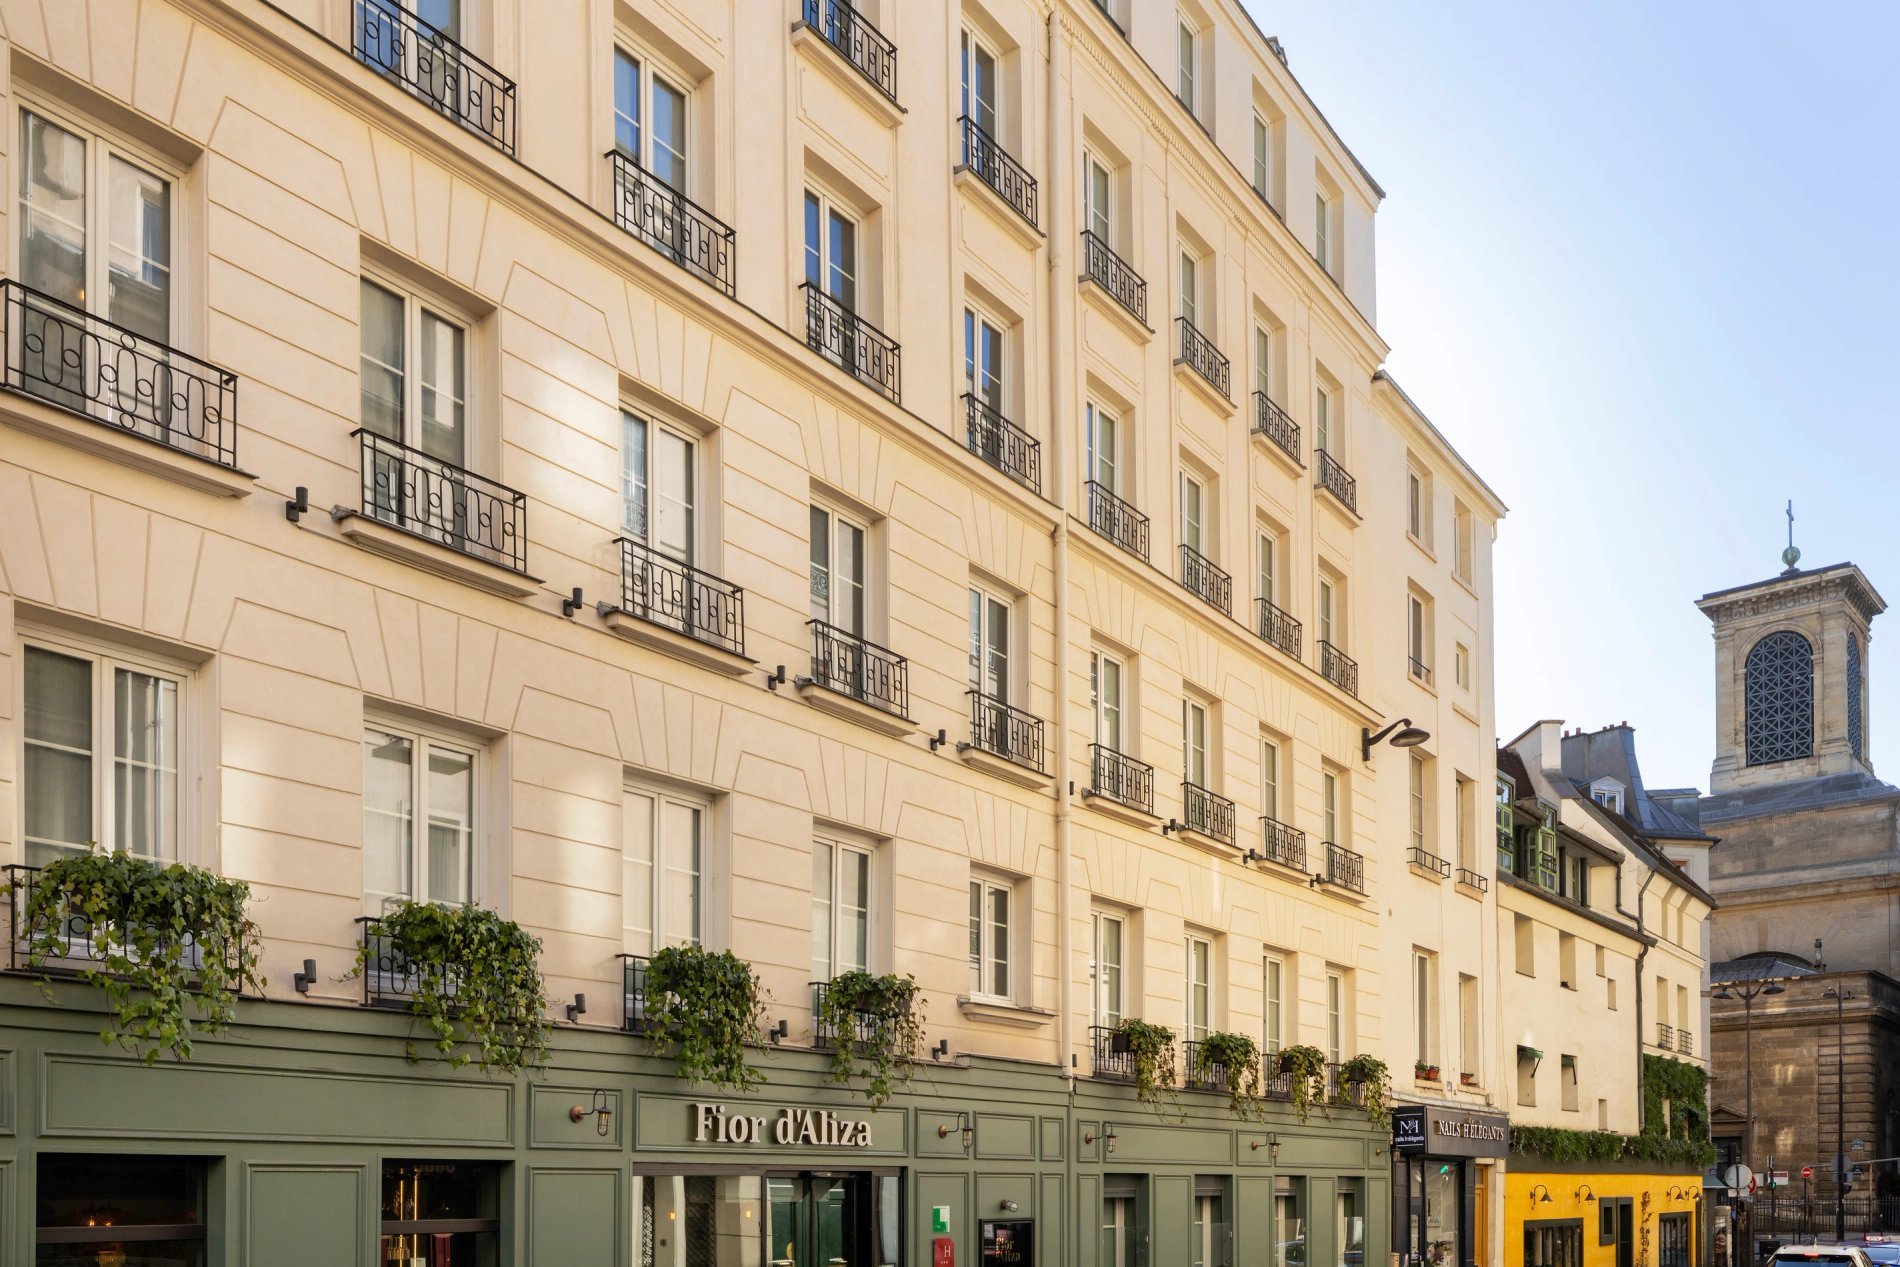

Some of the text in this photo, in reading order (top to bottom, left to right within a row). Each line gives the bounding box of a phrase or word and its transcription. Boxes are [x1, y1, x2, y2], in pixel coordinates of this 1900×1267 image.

[695, 1103, 873, 1146] Fior d'Aliza
[1439, 1120, 1461, 1137] NAILS
[944, 1246, 951, 1258] H
